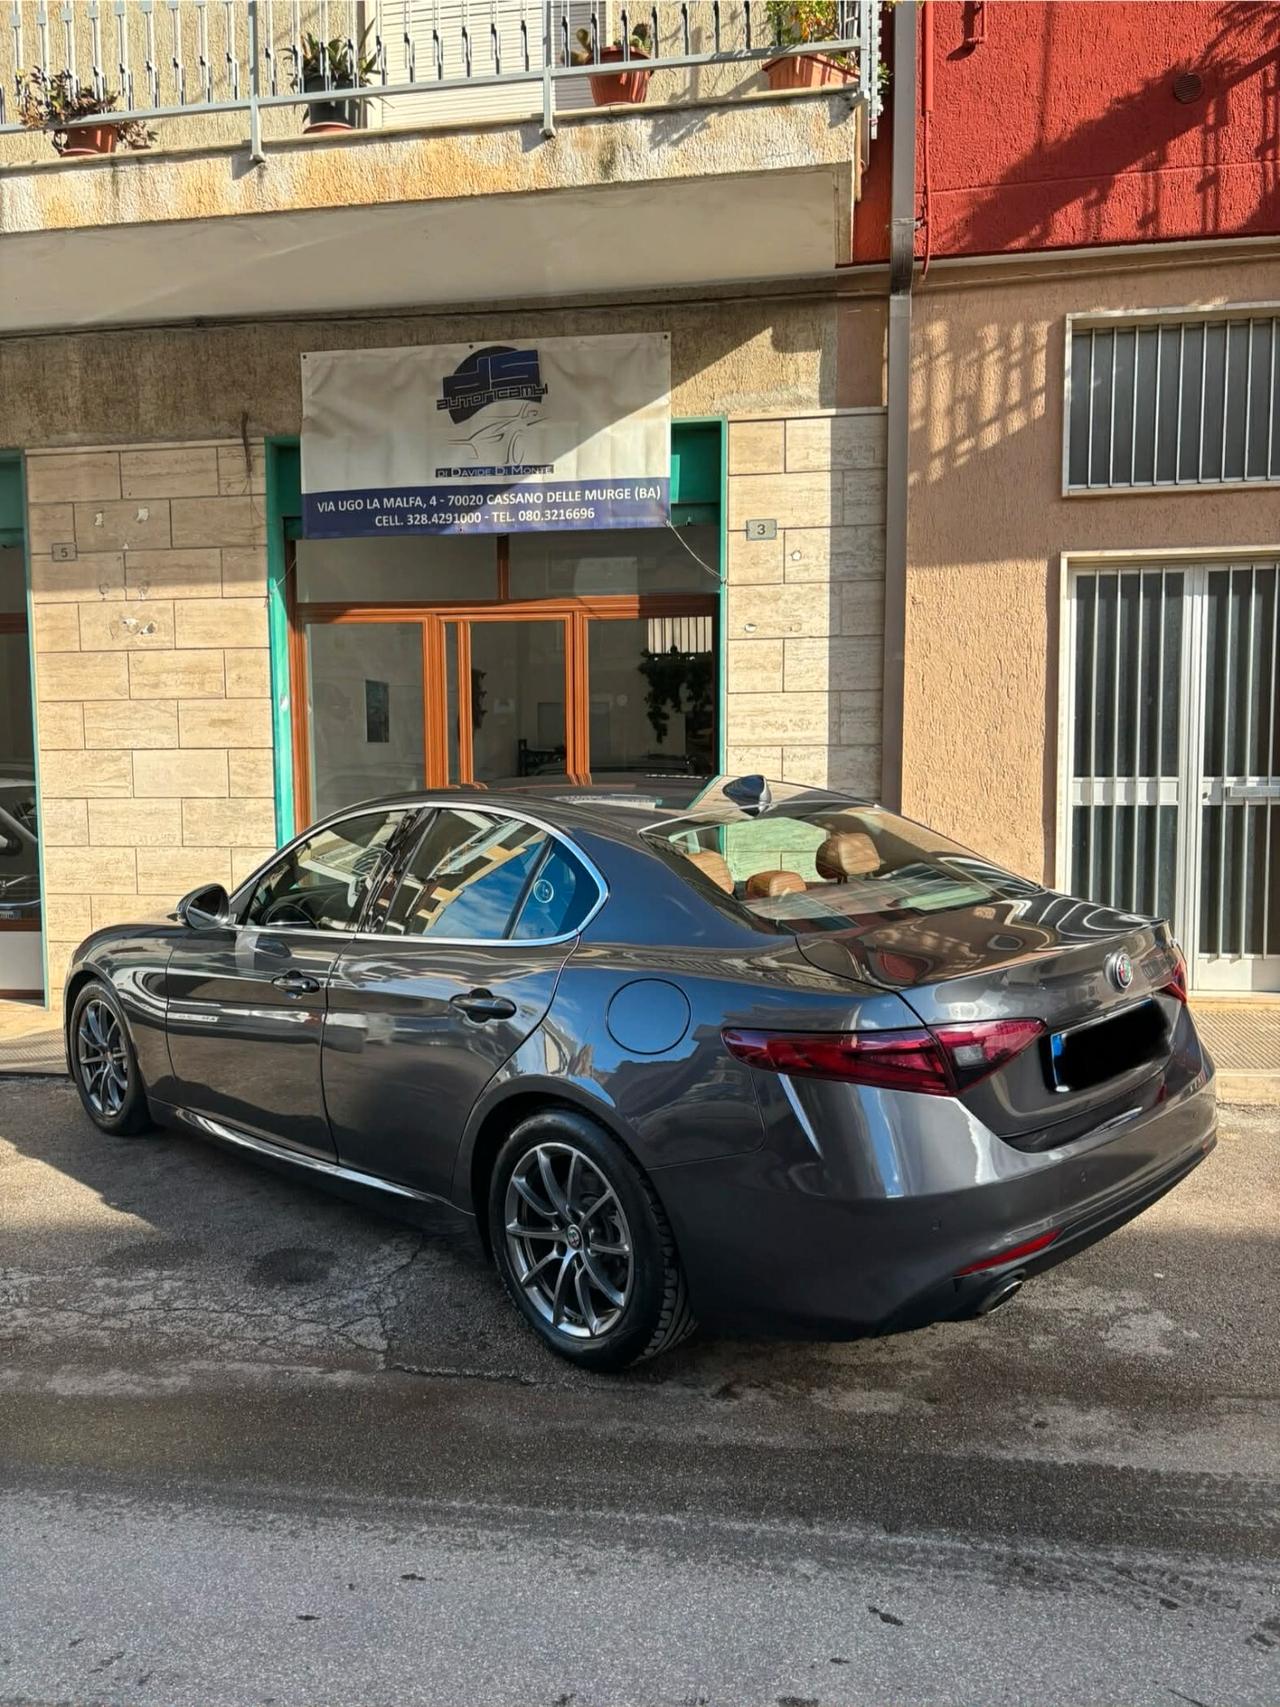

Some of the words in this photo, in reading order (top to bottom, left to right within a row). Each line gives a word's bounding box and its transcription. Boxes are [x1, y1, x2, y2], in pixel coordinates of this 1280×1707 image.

[317, 501, 336, 513] VIA
[338, 499, 364, 511] UGO
[366, 498, 380, 509] LA
[383, 496, 427, 509] MALFA,
[429, 495, 437, 507] 4
[447, 494, 483, 507] 70020
[486, 492, 544, 505] CASSANO
[547, 490, 582, 503] DELLE
[584, 488, 631, 501] MURGE
[634, 485, 661, 501] (BA)
[375, 515, 404, 527] CELL.
[406, 512, 482, 526] 328.4291000
[491, 511, 515, 523] TEL.
[518, 507, 595, 521] 080.3216696
[757, 523, 766, 535] 3
[61, 547, 68, 558] 5
